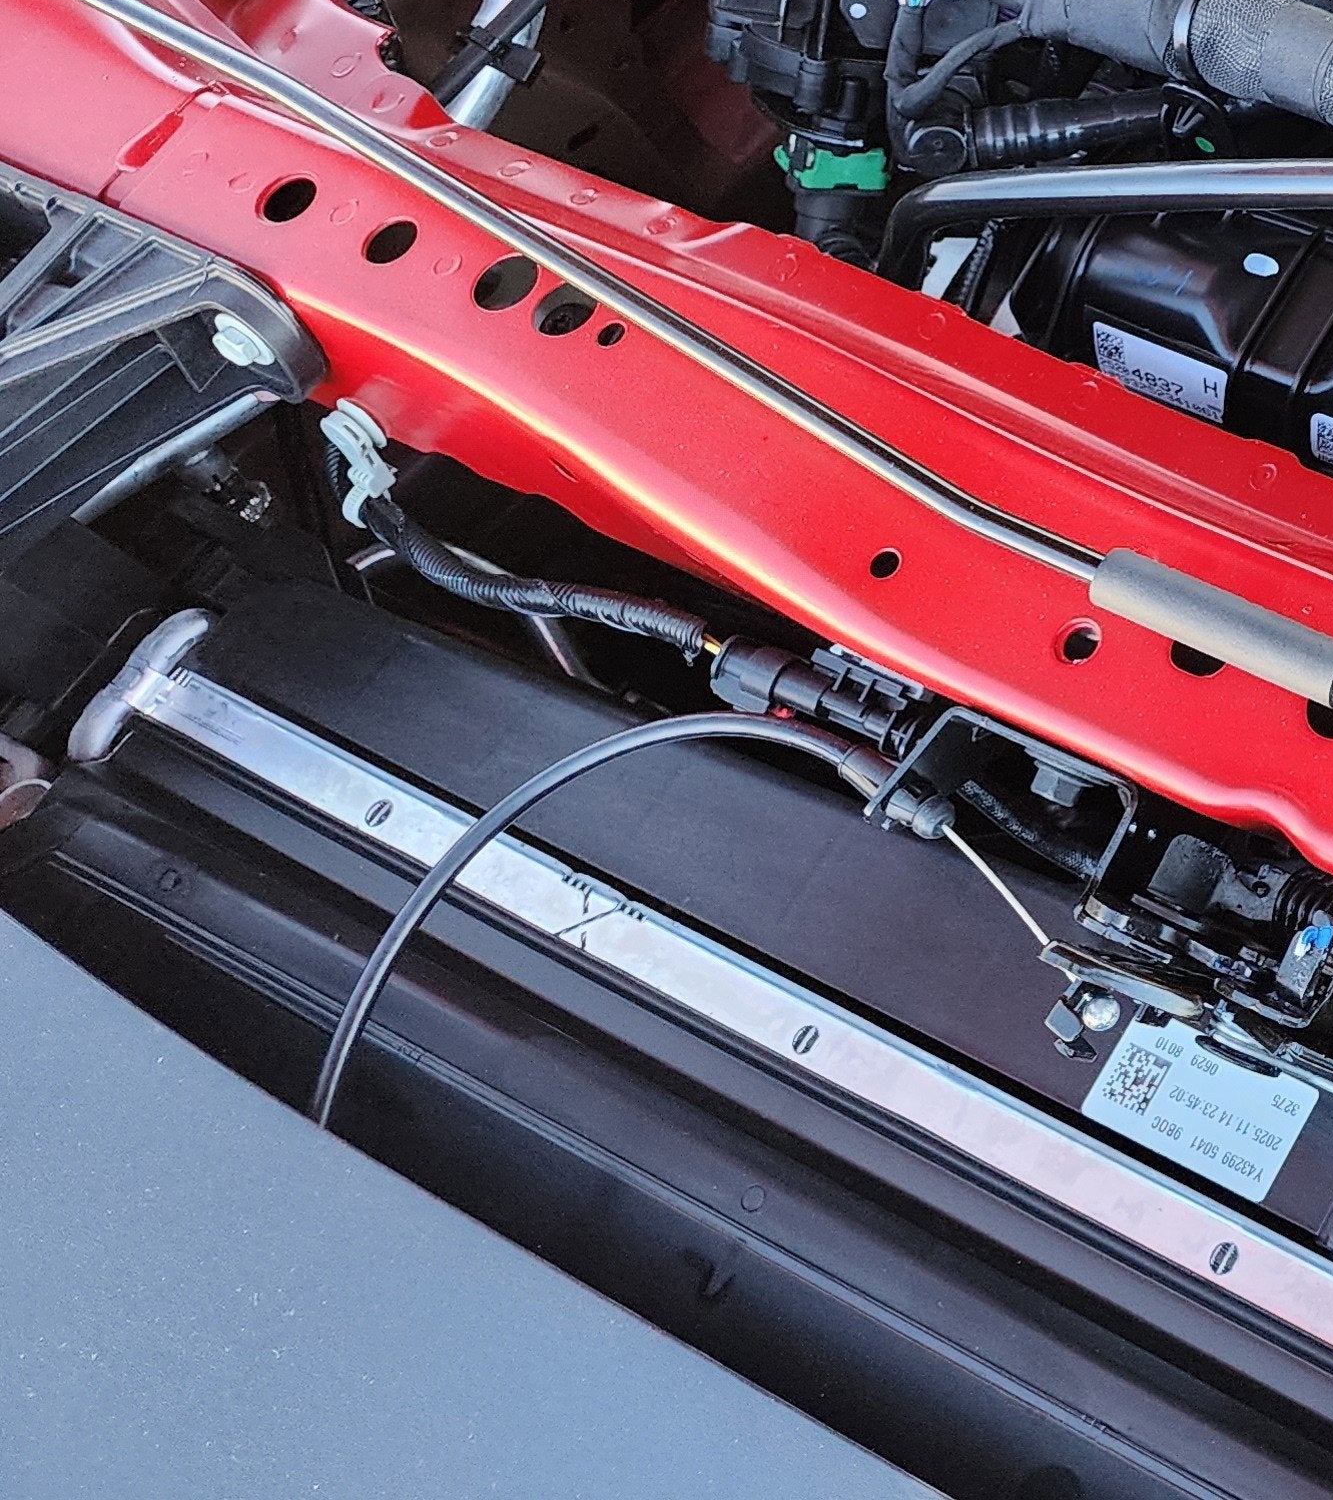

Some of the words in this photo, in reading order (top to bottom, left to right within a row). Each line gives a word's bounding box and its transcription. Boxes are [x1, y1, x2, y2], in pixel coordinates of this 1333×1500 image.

[1203, 377, 1219, 398] H
[1155, 1036, 1183, 1058] 8010
[1190, 1054, 1218, 1076] 0629
[1168, 1085, 1216, 1120] 23:45:02
[1271, 1094, 1301, 1116] 3275
[1213, 1110, 1283, 1151] 2025.11.14
[1190, 1136, 1219, 1158] 5041
[1220, 1150, 1266, 1183] Y43299
